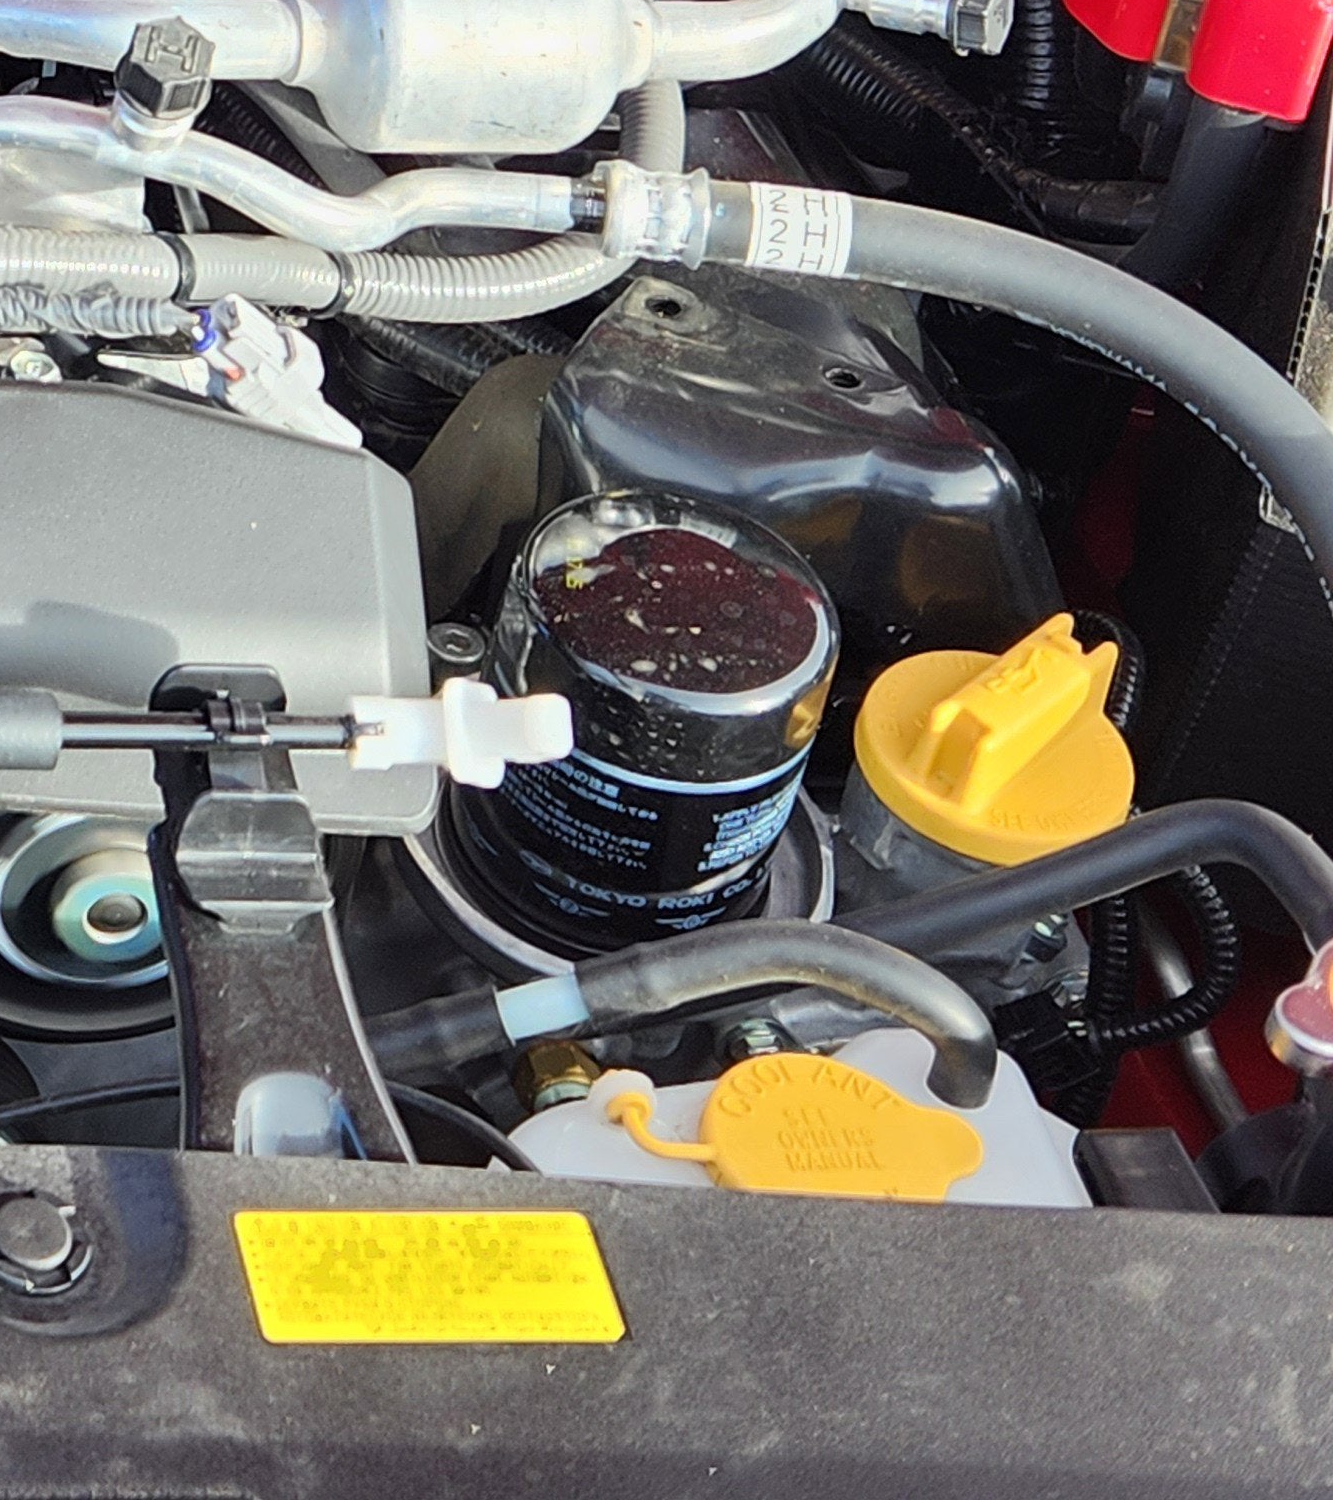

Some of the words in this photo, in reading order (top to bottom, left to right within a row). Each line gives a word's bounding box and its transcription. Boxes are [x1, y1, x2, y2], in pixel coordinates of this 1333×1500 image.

[564, 872, 649, 908] TOKYO
[658, 891, 715, 910] ROKI
[717, 1058, 902, 1118] COOLANT
[785, 1150, 883, 1174] MANUAL
